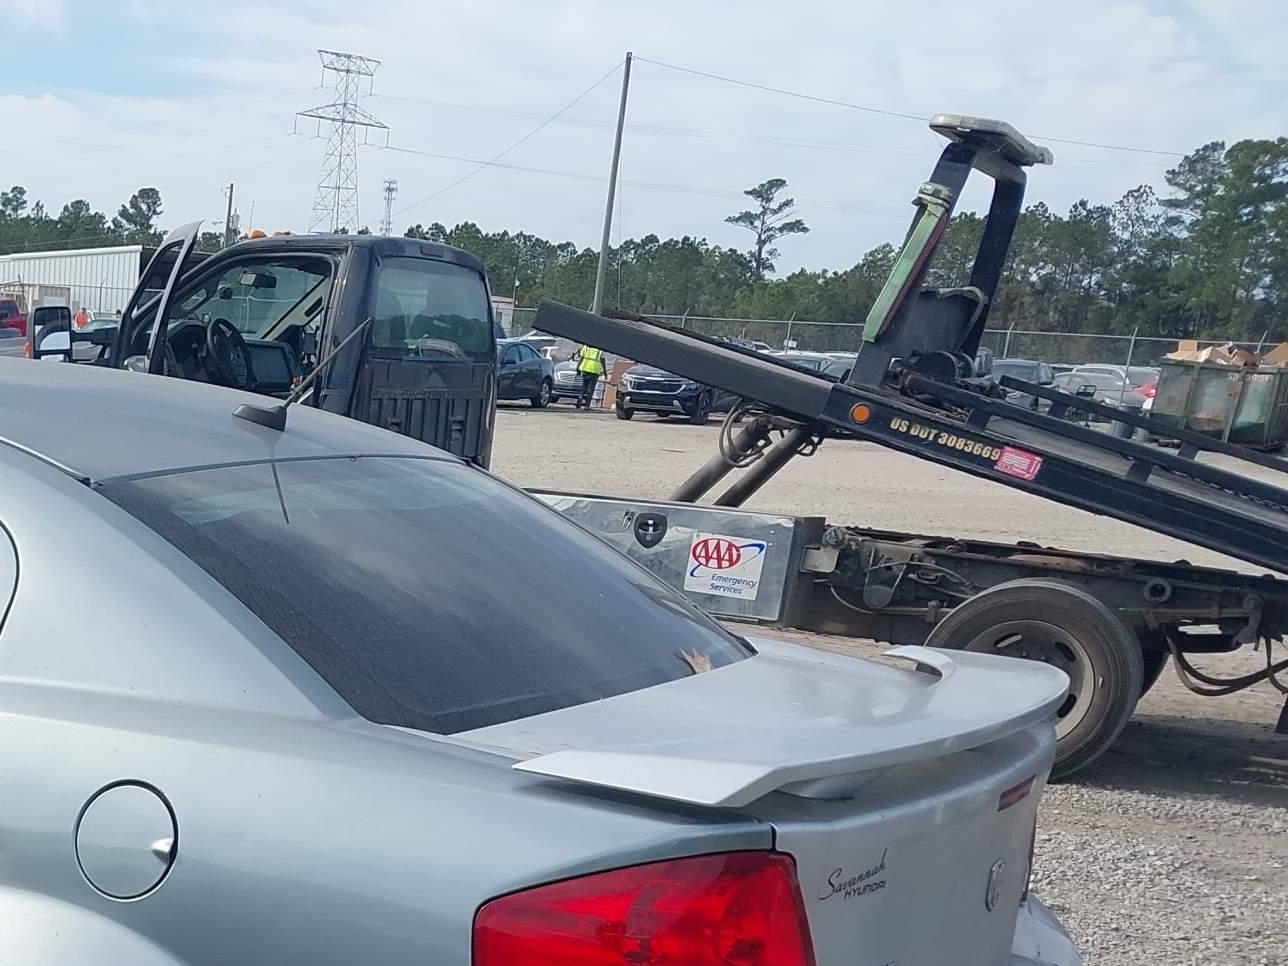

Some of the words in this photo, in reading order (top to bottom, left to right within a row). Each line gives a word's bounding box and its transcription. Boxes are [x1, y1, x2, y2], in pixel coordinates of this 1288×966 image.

[890, 417, 909, 432] US
[910, 425, 938, 441] DOT
[938, 432, 1001, 461] 3083669
[695, 539, 737, 569] AAA
[710, 583, 744, 595] Services
[711, 573, 758, 589] Emergency
[818, 848, 888, 900] Savannah
[844, 880, 888, 899] HYUNDAI
